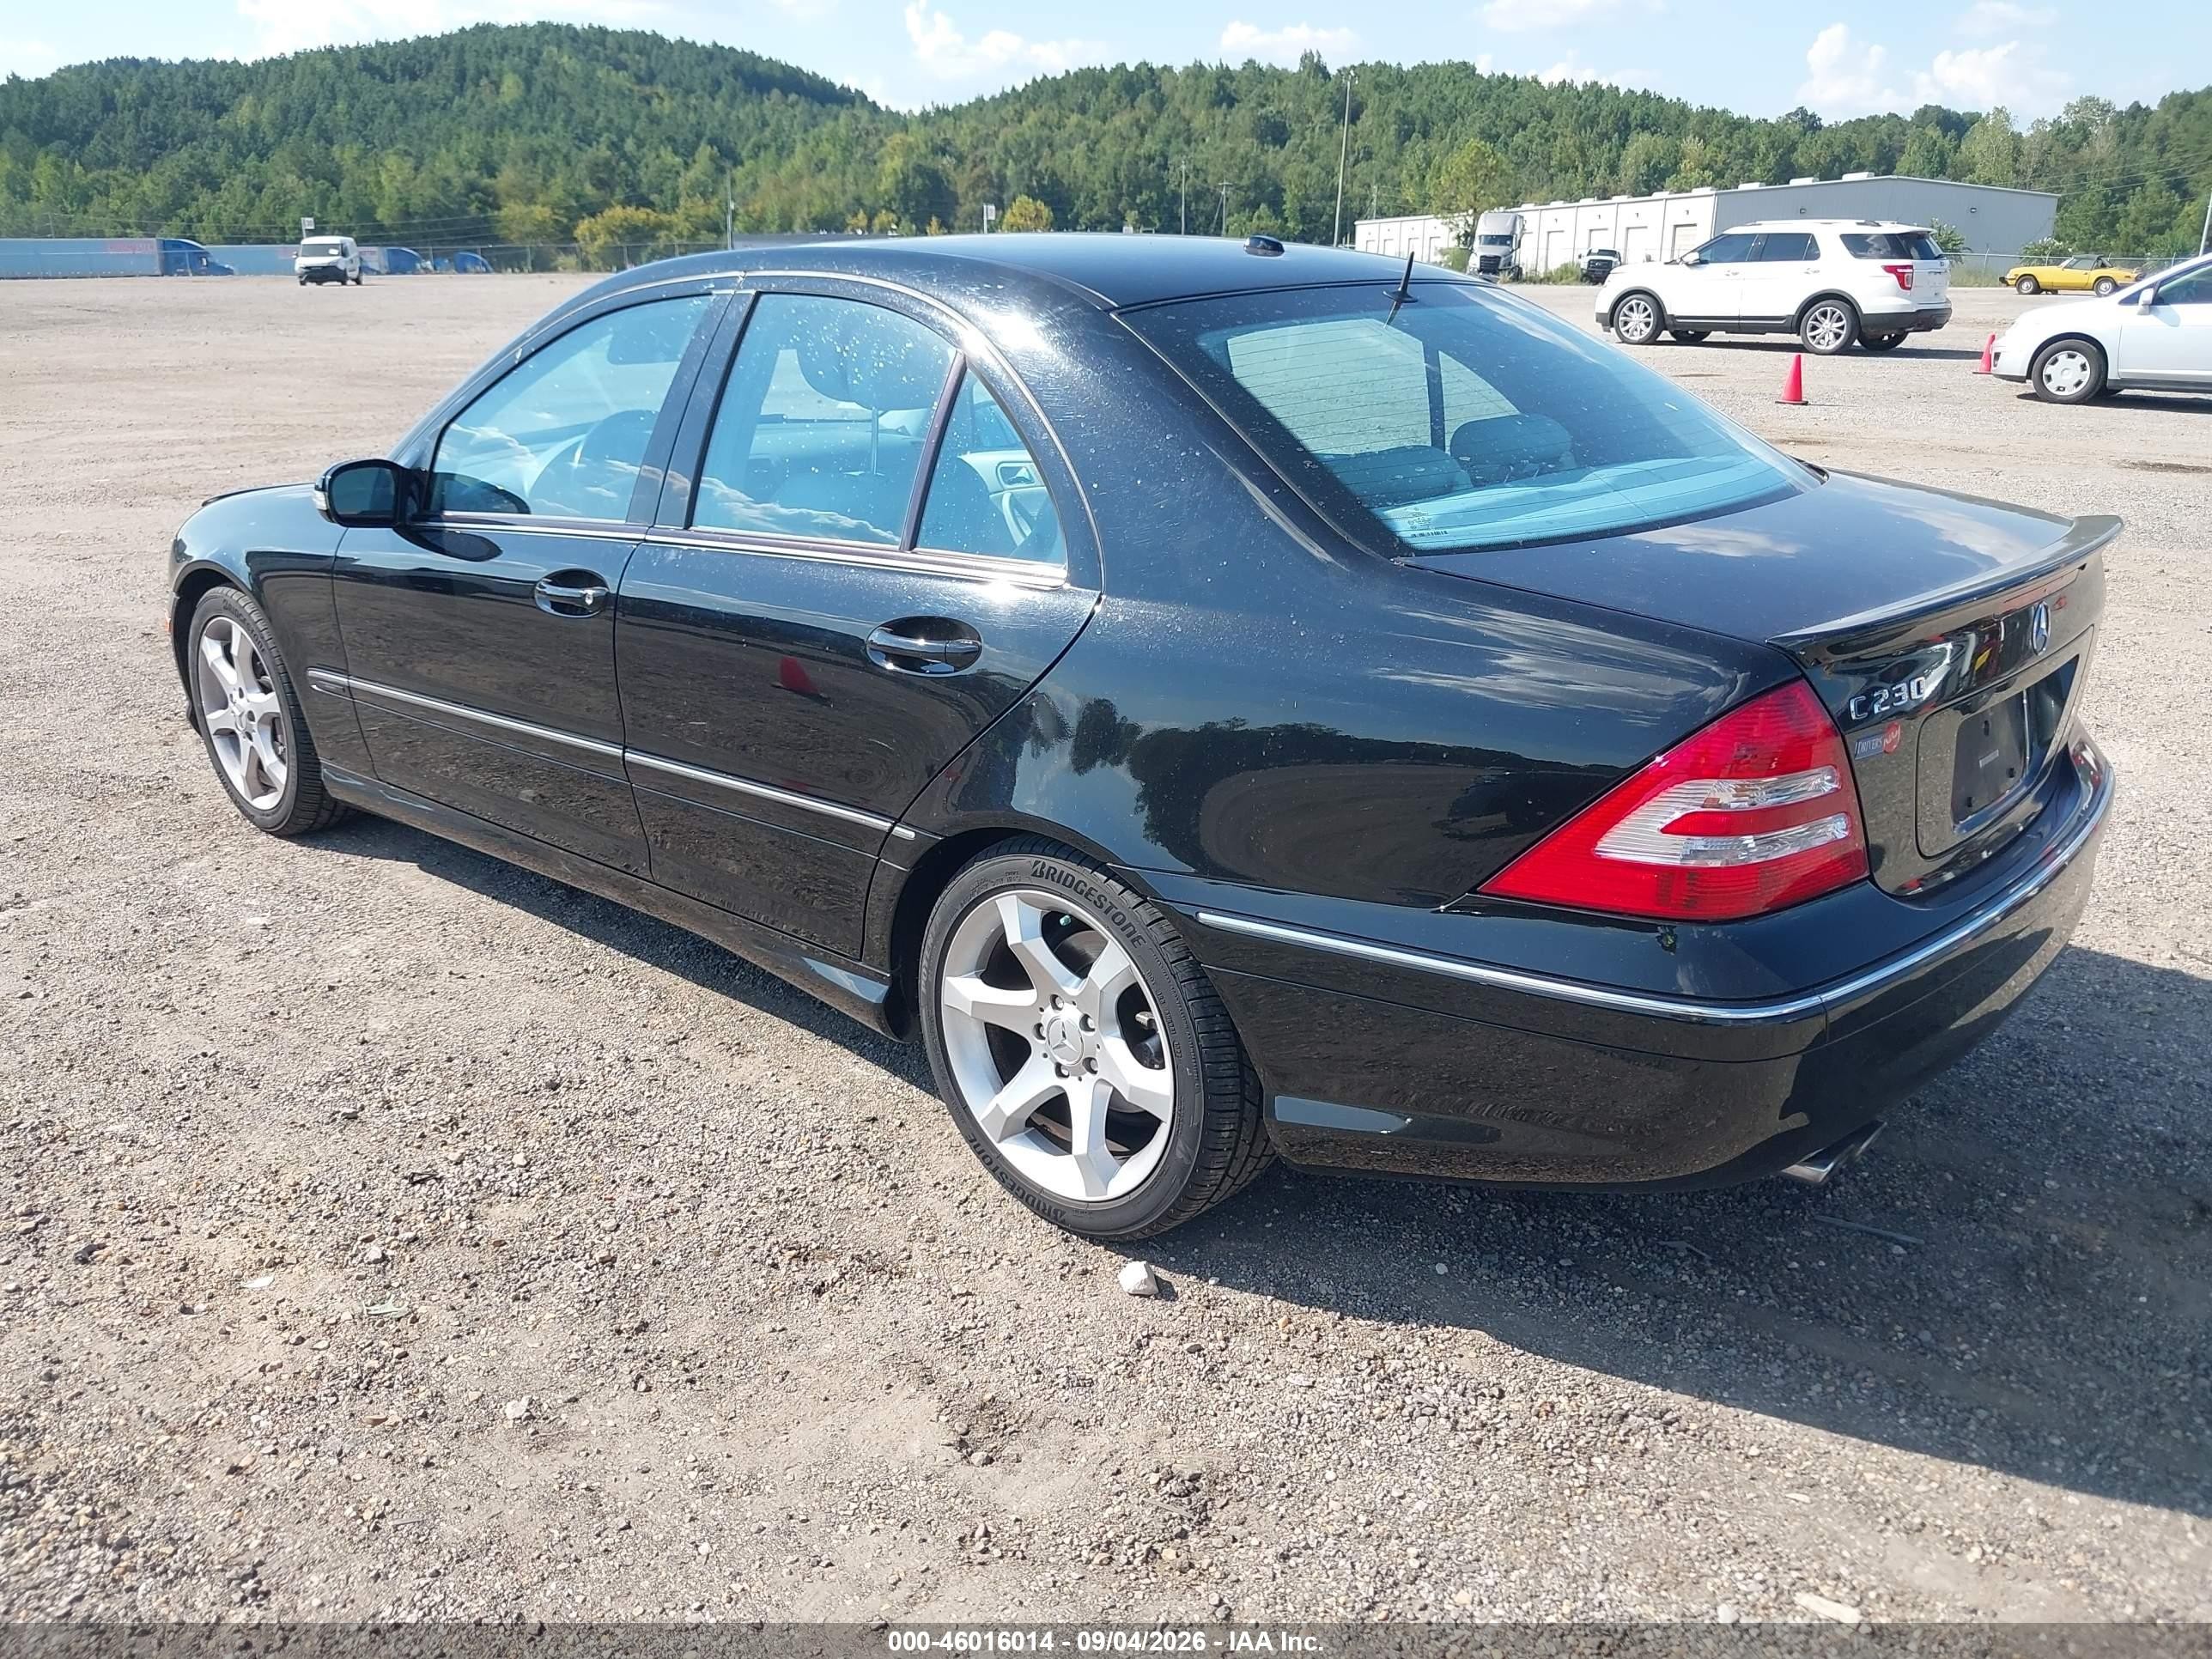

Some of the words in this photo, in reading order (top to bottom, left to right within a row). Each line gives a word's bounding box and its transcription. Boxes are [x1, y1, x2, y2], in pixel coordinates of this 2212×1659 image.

[1850, 696, 1869, 720] C
[1873, 677, 1925, 714] 230
[1030, 860, 1146, 949] BRIDGESTONE
[966, 1132, 1066, 1223] BRIDGESTONE
